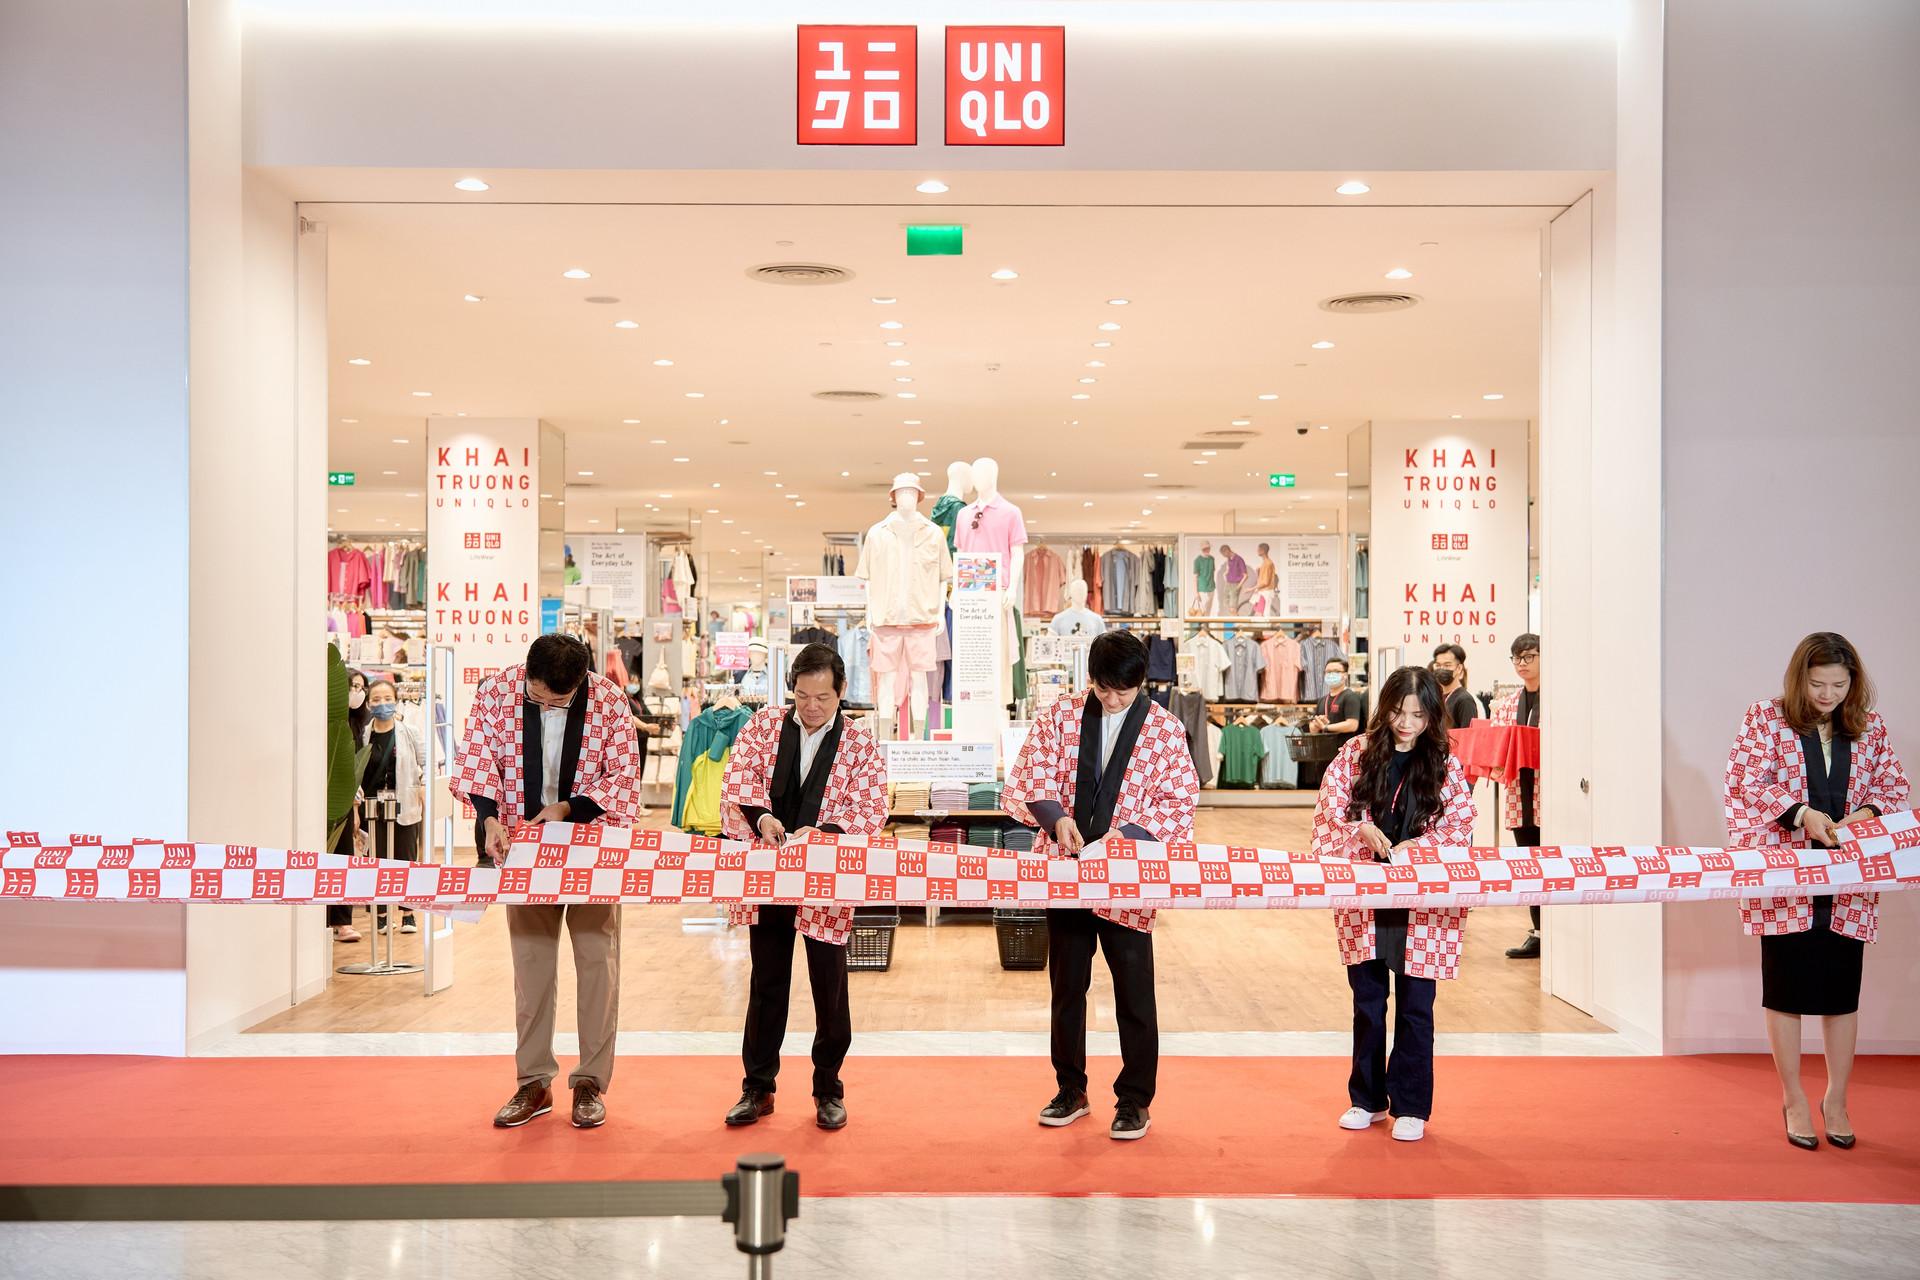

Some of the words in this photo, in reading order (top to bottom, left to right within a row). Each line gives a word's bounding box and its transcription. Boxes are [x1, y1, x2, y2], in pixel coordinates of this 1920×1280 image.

[815, 42, 899, 80] ユニ
[960, 42, 1041, 81] UNI
[812, 91, 899, 128] クロ
[960, 90, 1050, 136] QLO
[438, 448, 528, 466] KHAI
[1406, 449, 1495, 468] KHAI
[437, 498, 528, 509] UNIQLO
[1404, 499, 1496, 511] UNIQLO
[438, 582, 527, 601] KHAI
[1406, 584, 1494, 602] KHAI
[436, 633, 528, 644] UNIQLO
[1404, 634, 1495, 644] UNIQLO
[574, 835, 598, 843] クロ
[634, 838, 657, 846] クロ
[694, 840, 717, 850] クロ
[107, 849, 128, 858] UNI
[168, 848, 190, 858] UNI
[541, 847, 564, 857] UNI
[602, 852, 623, 861] UNI
[840, 849, 861, 858] UNI
[1111, 849, 1133, 857] クロ
[1171, 850, 1193, 859] クロ
[1232, 851, 1254, 860] クロ
[38, 857, 63, 867] QLO
[229, 858, 253, 867] QLO
[291, 856, 314, 868] QLO
[719, 857, 742, 868] QLO
[780, 858, 802, 868] QLO
[840, 860, 863, 871] QLO
[1704, 858, 1730, 868] QLO
[1769, 855, 1795, 866] QLO
[900, 863, 923, 873] QLO
[960, 866, 983, 876] QLO
[1577, 864, 1602, 874] QLO
[1640, 861, 1666, 871] QLO
[382, 872, 404, 881] ユニ
[443, 871, 465, 880] ユニ
[504, 871, 527, 880] ユニ
[566, 872, 588, 881] ユニ
[1020, 868, 1045, 880] QLO
[1082, 870, 1105, 881] QLO
[1142, 871, 1166, 881] QLO
[1204, 872, 1228, 881] QLO
[1389, 870, 1413, 880] QLO
[1451, 869, 1476, 878] QLO
[1514, 867, 1539, 876] QLO
[1866, 865, 1891, 878] クロ
[9, 872, 32, 882] ユニ
[72, 873, 94, 882] ユニ
[134, 873, 156, 882] ユニ
[196, 873, 218, 882] ユニ
[258, 872, 280, 882] ユニ
[319, 872, 342, 882] ユニ
[627, 873, 648, 882] ユニ
[689, 874, 709, 883] ユニ
[749, 875, 770, 884] ユニ
[809, 876, 831, 886] ユニ
[1265, 872, 1290, 882] QLO
[1327, 872, 1351, 882] QLO
[441, 883, 464, 892] クロ
[502, 882, 526, 892] クロ
[564, 884, 588, 892] クロ
[870, 879, 892, 888] ユニ
[931, 882, 952, 891] ユニ
[1548, 881, 1570, 890] ユニ
[1610, 878, 1632, 888] ユニ
[6, 885, 31, 894] クロ
[69, 886, 94, 894] クロ
[132, 886, 156, 895] クロ
[193, 885, 218, 895] クロ
[256, 885, 280, 895] クロ
[318, 884, 341, 894] クロ
[379, 884, 402, 894] クロ
[625, 885, 648, 893] クロ
[686, 886, 709, 894] クロ
[747, 886, 770, 895] クロ
[808, 888, 831, 896] クロ
[992, 884, 1014, 894] ユニ
[1053, 886, 1074, 896] ユニ
[1114, 887, 1135, 897] ユニ
[869, 891, 892, 899] クロ
